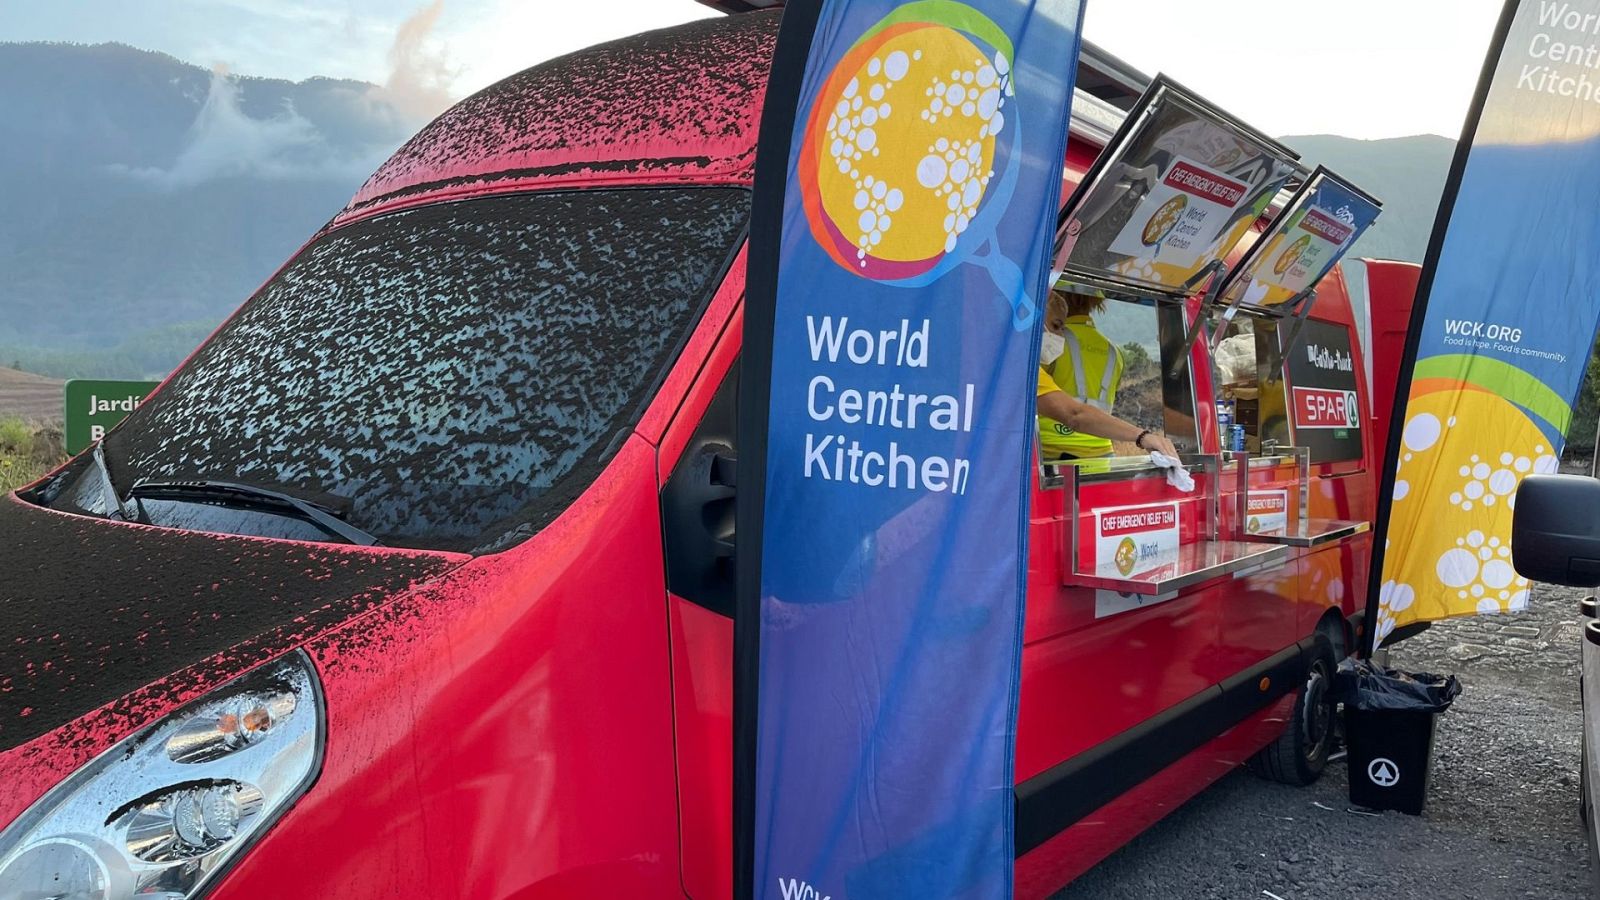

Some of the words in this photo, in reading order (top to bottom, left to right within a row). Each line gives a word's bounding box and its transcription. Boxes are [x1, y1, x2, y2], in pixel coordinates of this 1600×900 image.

[1538, 1, 1600, 35] Worl
[1528, 33, 1600, 69] Cent
[806, 315, 930, 368] World
[1445, 319, 1522, 343] WCK.ORG
[1443, 336, 1464, 346] Food
[1465, 337, 1472, 346] is
[1493, 343, 1513, 353] Food
[1513, 345, 1520, 354] is
[1520, 348, 1567, 363] community.
[88, 395, 142, 416] Jardí
[807, 375, 975, 432] Central
[1306, 394, 1346, 421] SPAR
[804, 433, 970, 495] Kitchen
[1102, 517, 1116, 531] CHEF
[1117, 513, 1147, 529] EMERGENCY
[1147, 511, 1161, 526] RELIEF
[1162, 510, 1174, 524] TEAM
